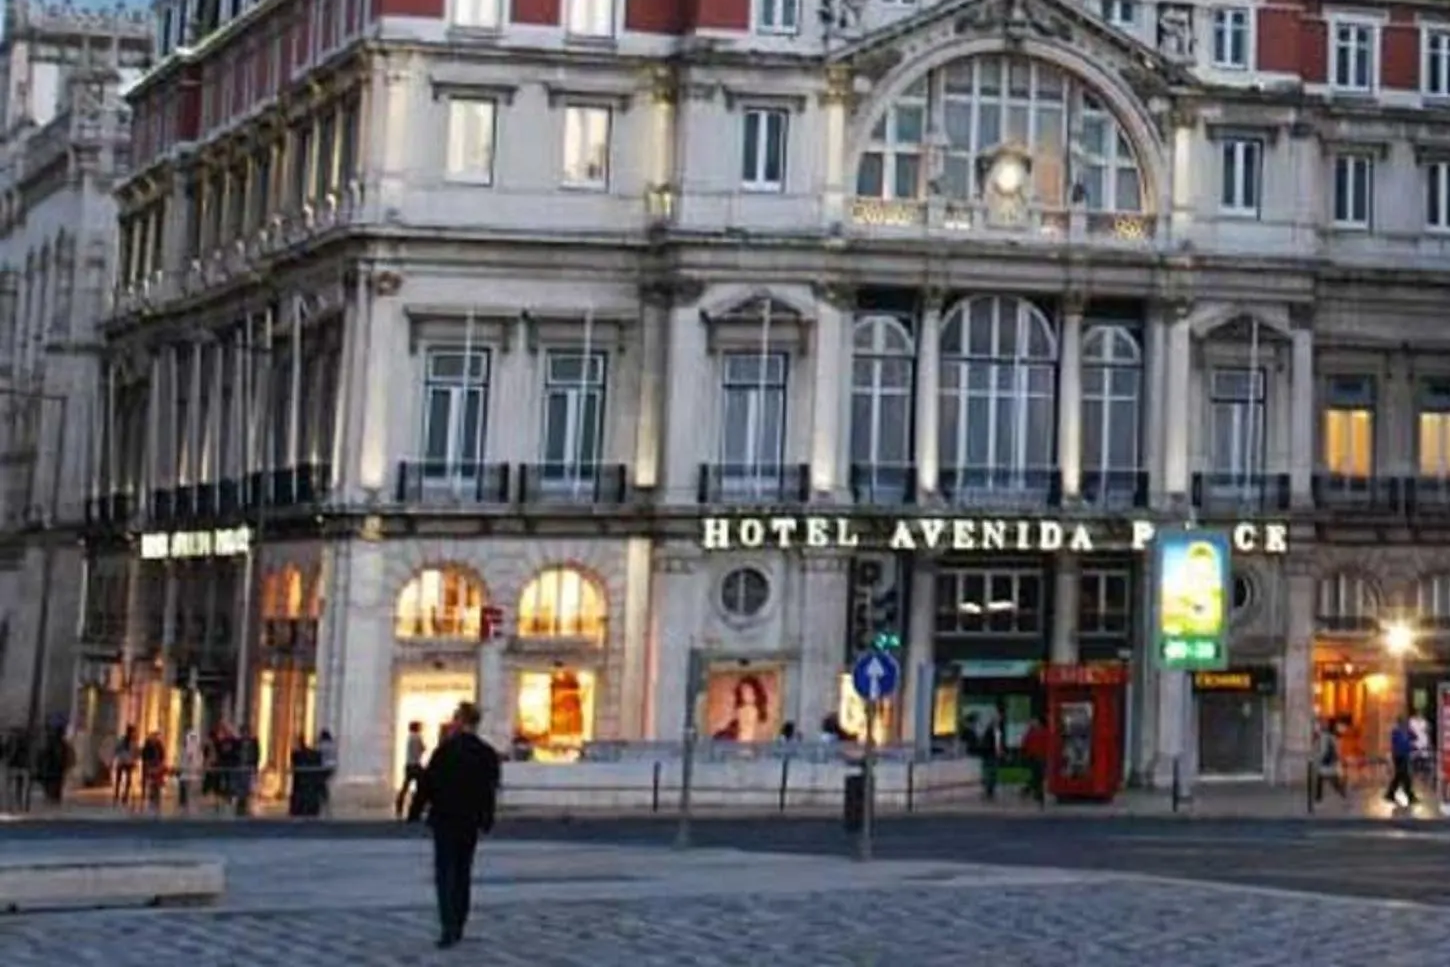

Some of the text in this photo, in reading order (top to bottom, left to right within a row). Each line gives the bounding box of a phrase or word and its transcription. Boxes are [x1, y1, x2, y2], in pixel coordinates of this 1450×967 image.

[704, 518, 1288, 552] HOTEL AVENIDA PCE
